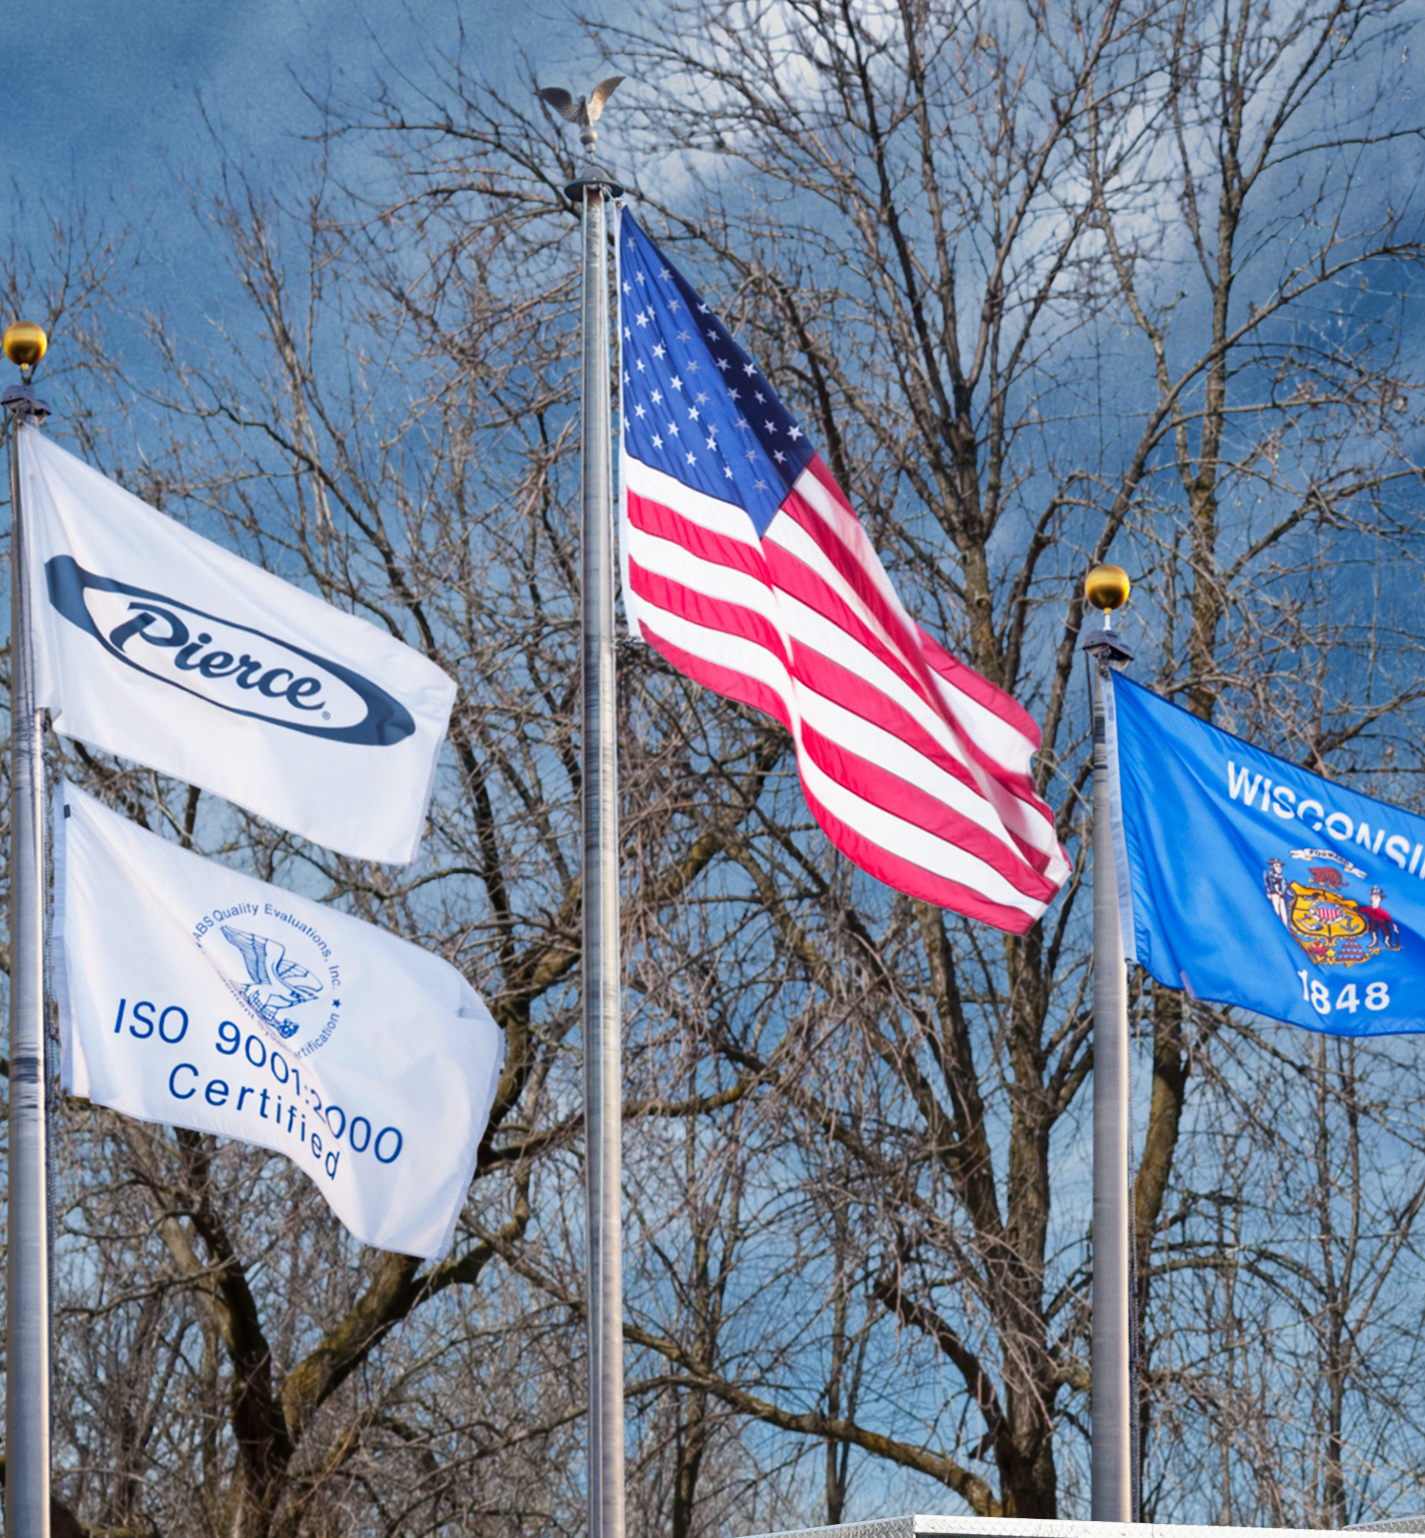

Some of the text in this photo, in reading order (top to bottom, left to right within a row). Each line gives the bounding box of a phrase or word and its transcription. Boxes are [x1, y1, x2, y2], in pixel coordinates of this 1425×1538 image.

[109, 601, 326, 711] Pierce
[192, 915, 215, 942] ABS
[212, 902, 259, 922] Quality
[328, 965, 342, 990] Inc.
[1297, 969, 1391, 1015] 1848
[113, 998, 189, 1044] ISO
[215, 1020, 403, 1164] 9001:2000
[293, 1012, 340, 1060] rtification
[168, 1062, 340, 1180] Certified
